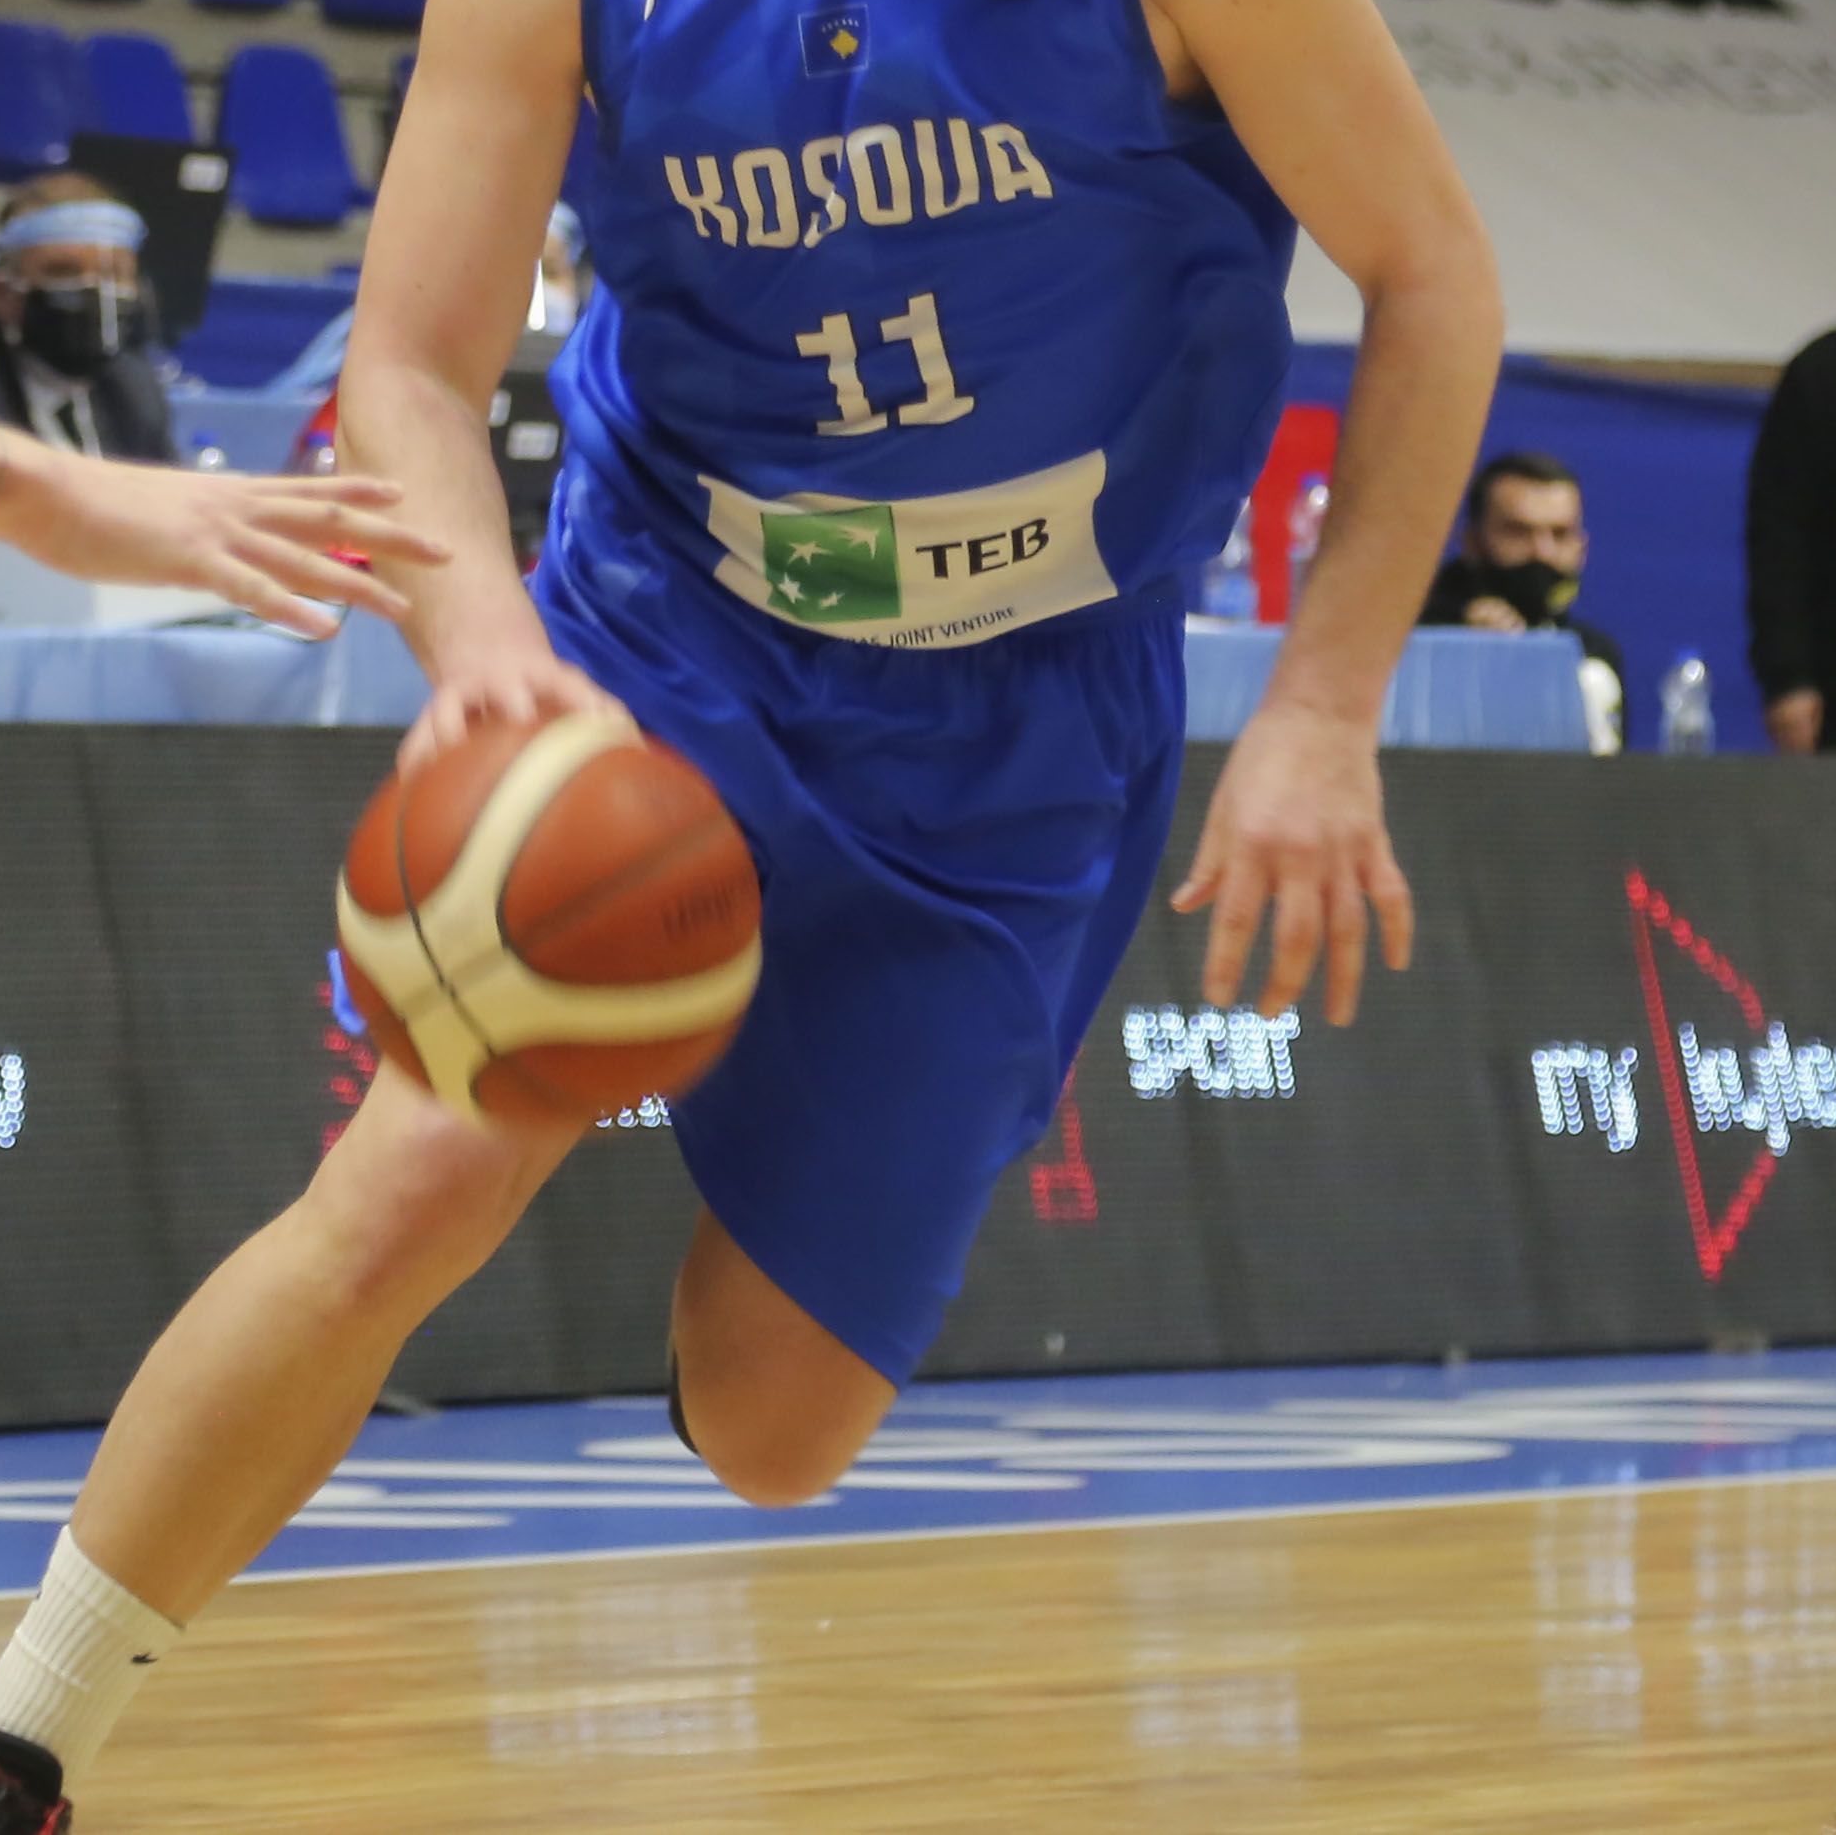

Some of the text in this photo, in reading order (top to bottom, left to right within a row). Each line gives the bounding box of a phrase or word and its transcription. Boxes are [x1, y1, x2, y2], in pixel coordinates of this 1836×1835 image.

[795, 292, 975, 437] 11
[916, 517, 1050, 580] TEB
[889, 626, 935, 648] JOINT
[939, 607, 1016, 638] VENTURE
